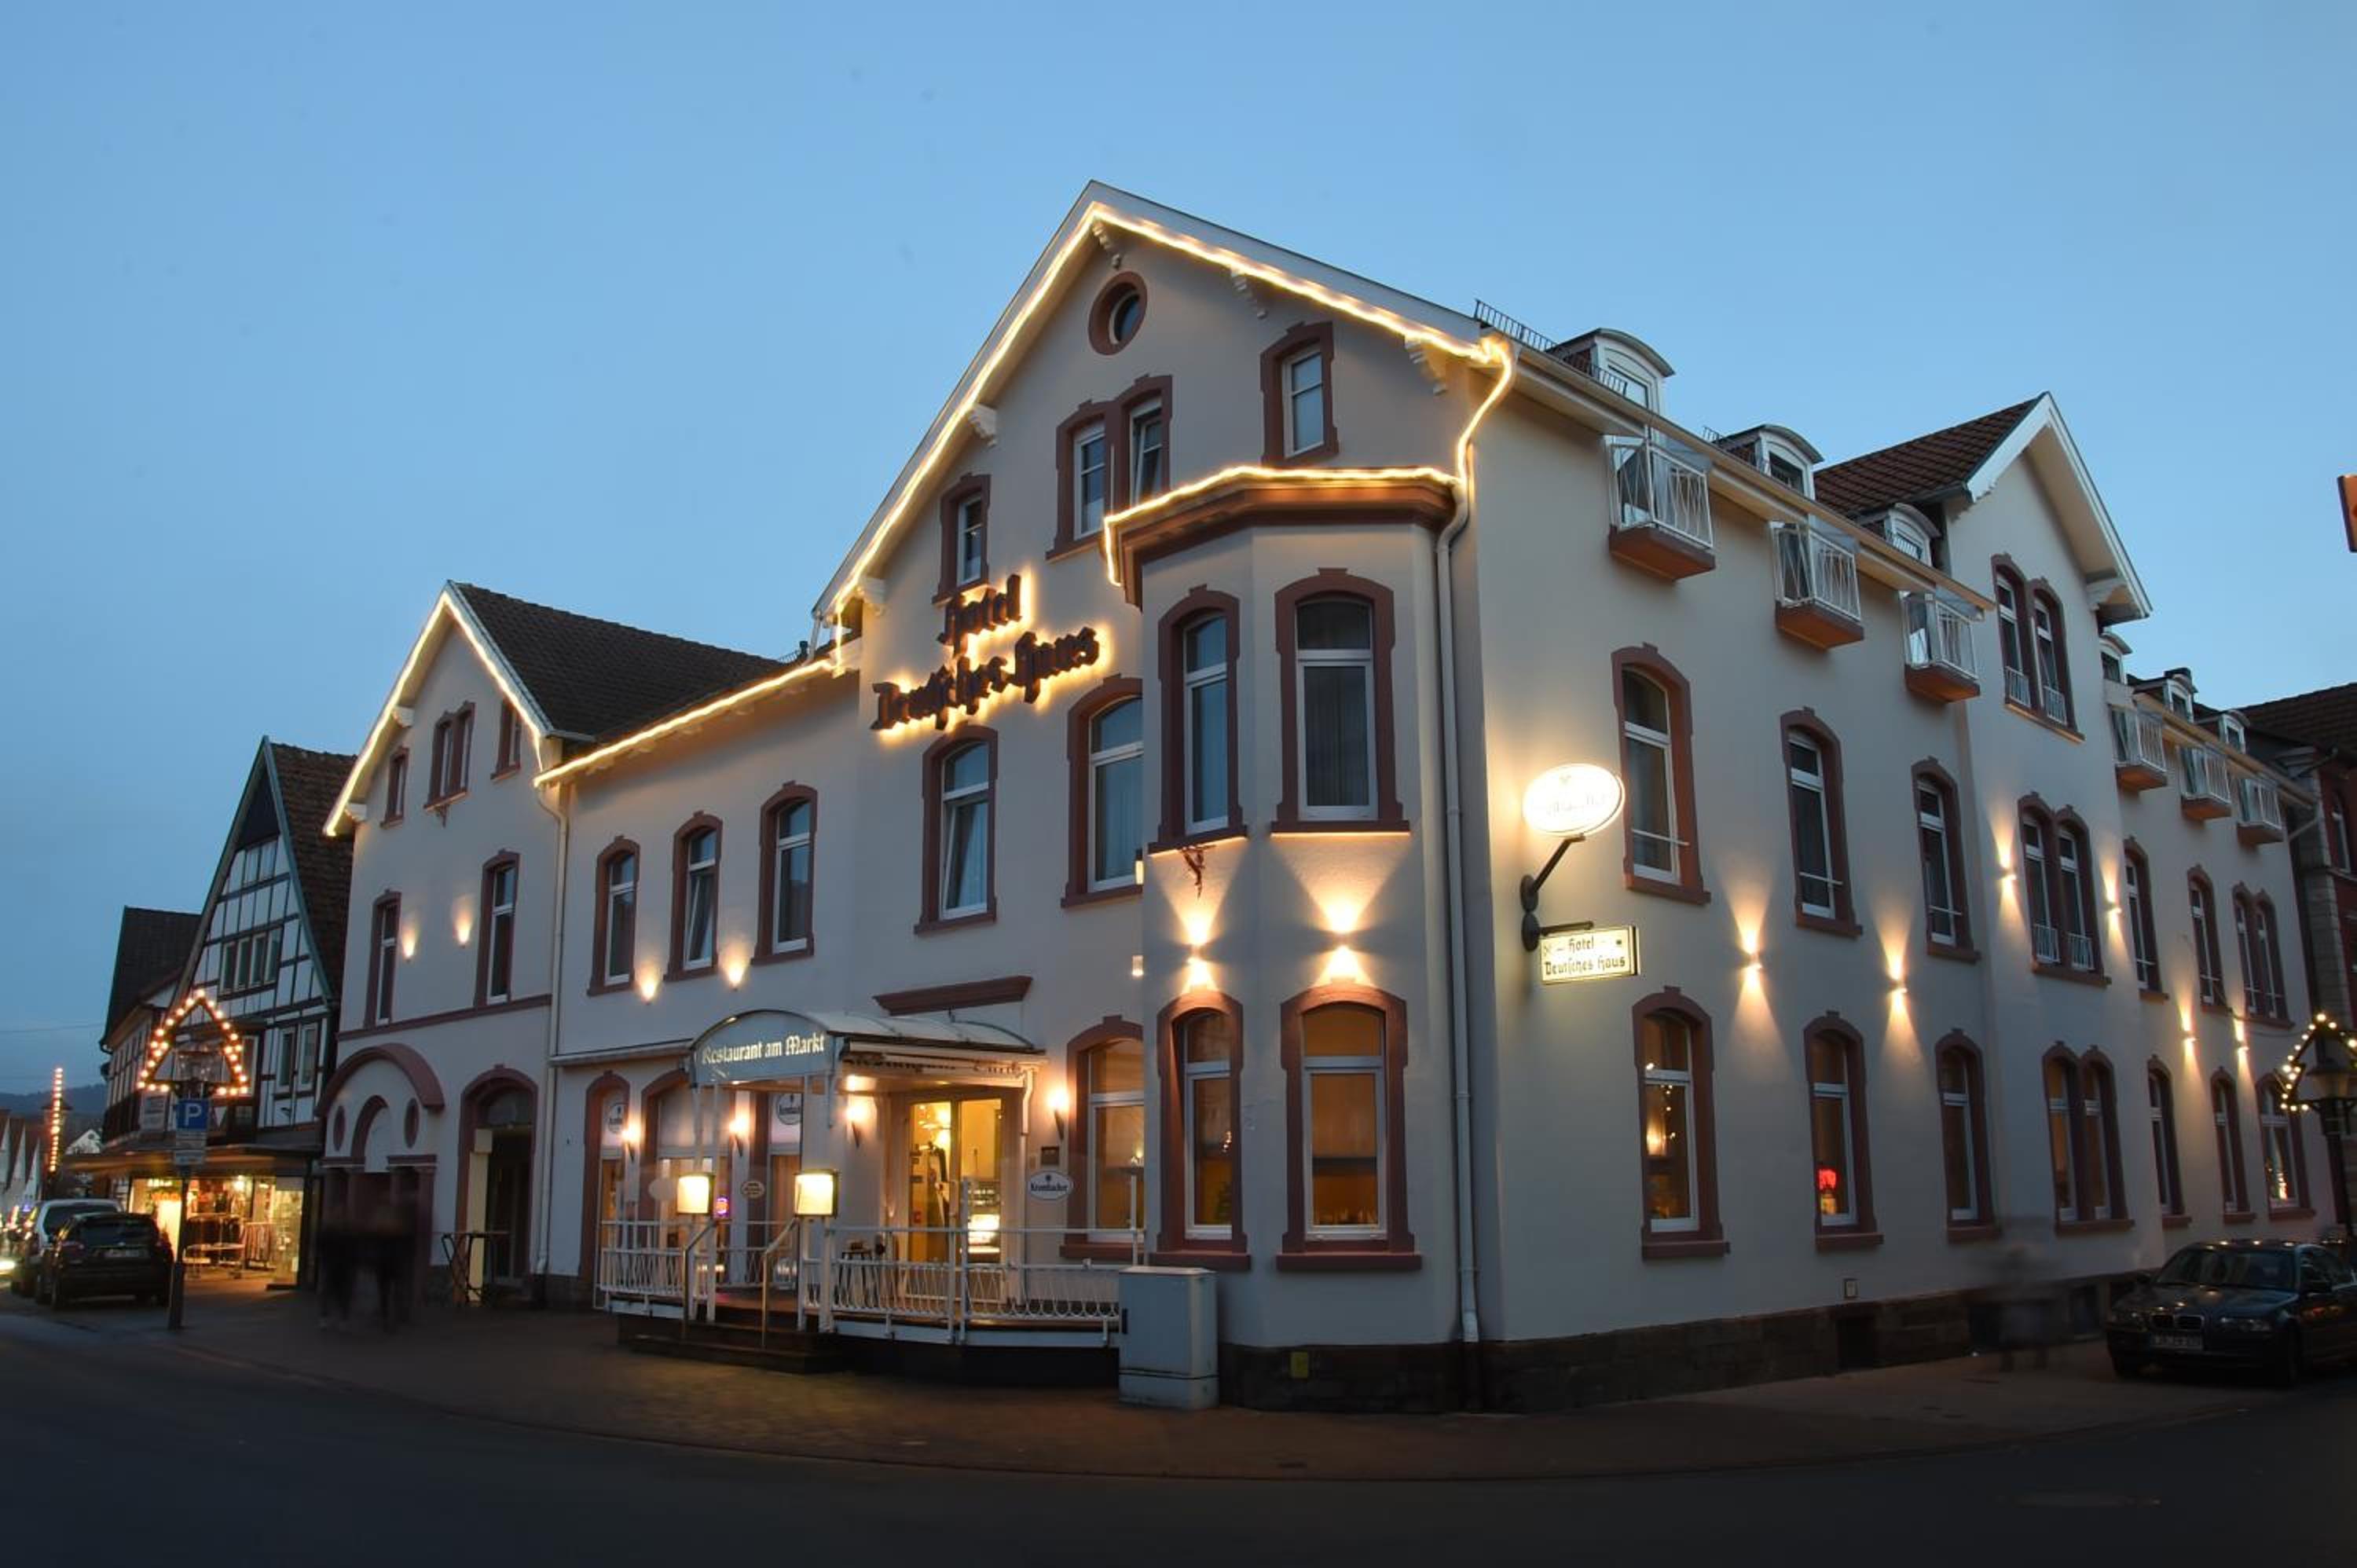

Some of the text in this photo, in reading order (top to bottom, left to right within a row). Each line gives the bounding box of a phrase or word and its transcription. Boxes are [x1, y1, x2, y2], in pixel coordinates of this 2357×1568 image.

[937, 573, 1022, 658] Hotel
[1006, 626, 1100, 704] Haus
[1568, 934, 1594, 954] Hotel
[1597, 954, 1626, 971] Haus
[702, 1032, 825, 1064] Restaurant am Markt
[185, 1102, 202, 1126] P
